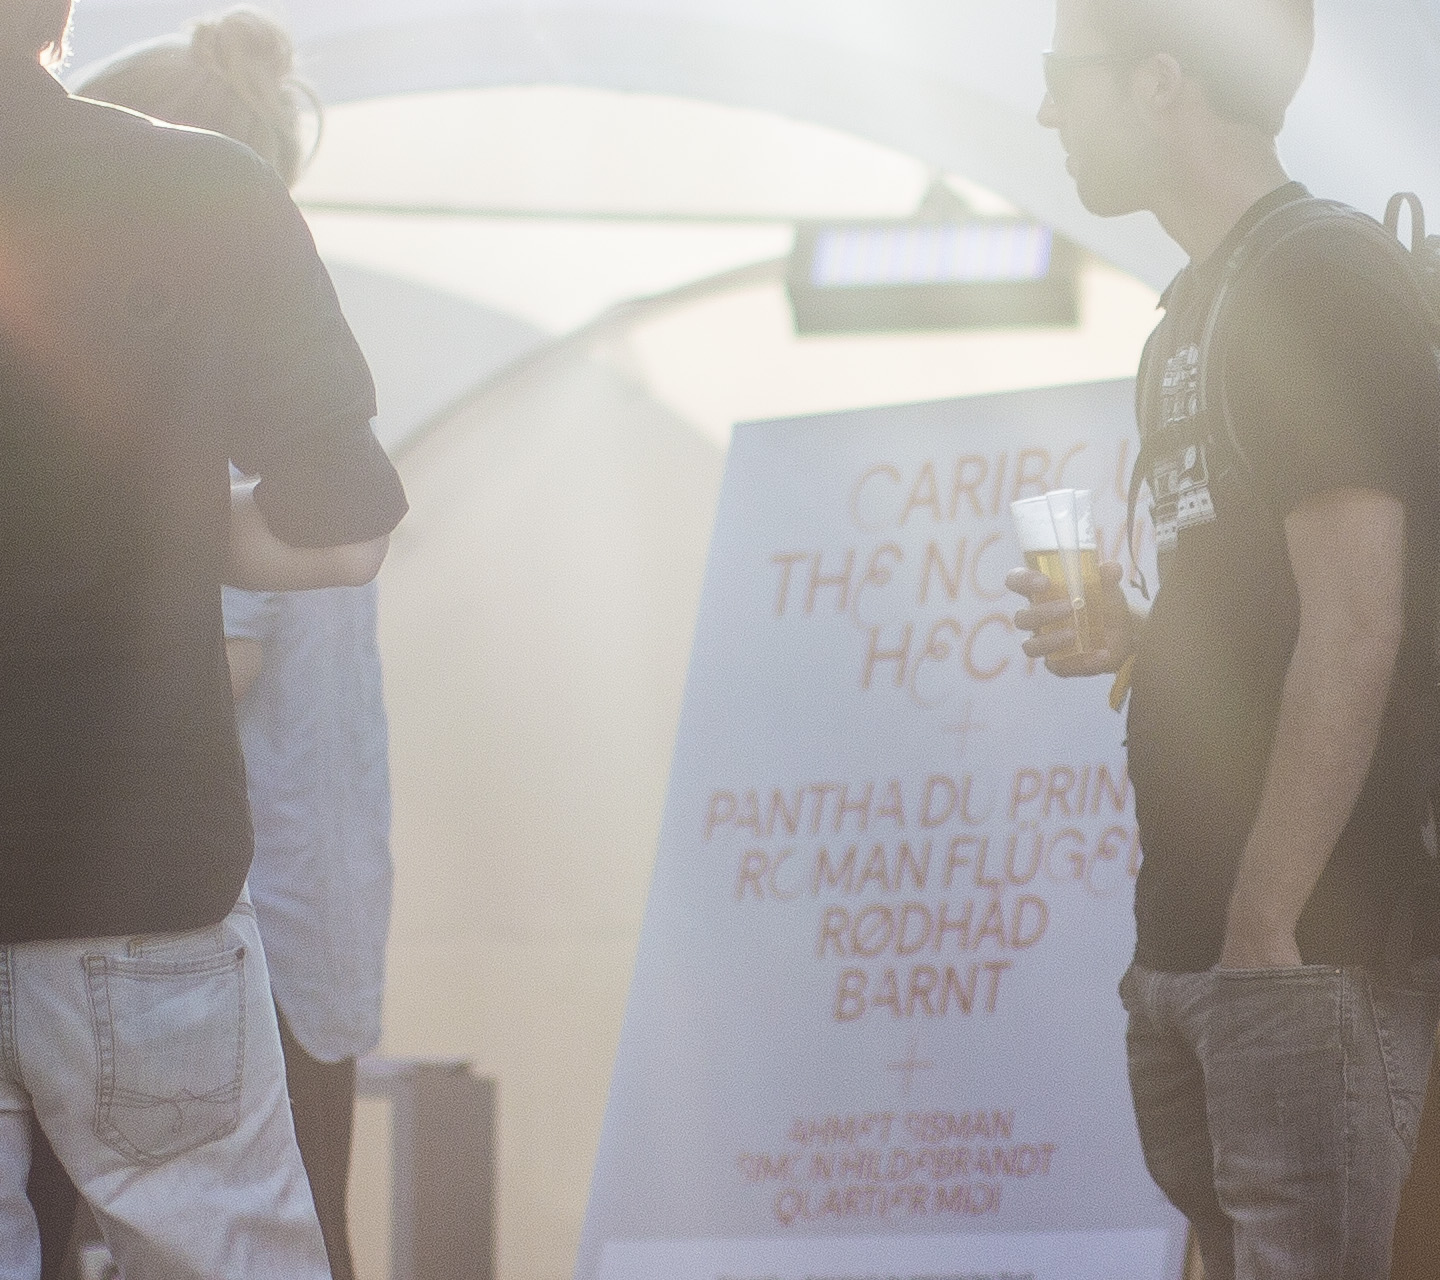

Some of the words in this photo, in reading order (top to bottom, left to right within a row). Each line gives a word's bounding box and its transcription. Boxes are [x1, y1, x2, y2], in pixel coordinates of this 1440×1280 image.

[768, 543, 905, 628] THE
[702, 778, 907, 842] PANTHA
[1009, 763, 1130, 822] PRIN
[734, 838, 932, 902] ROMAN
[833, 958, 1015, 1022] BARNT
